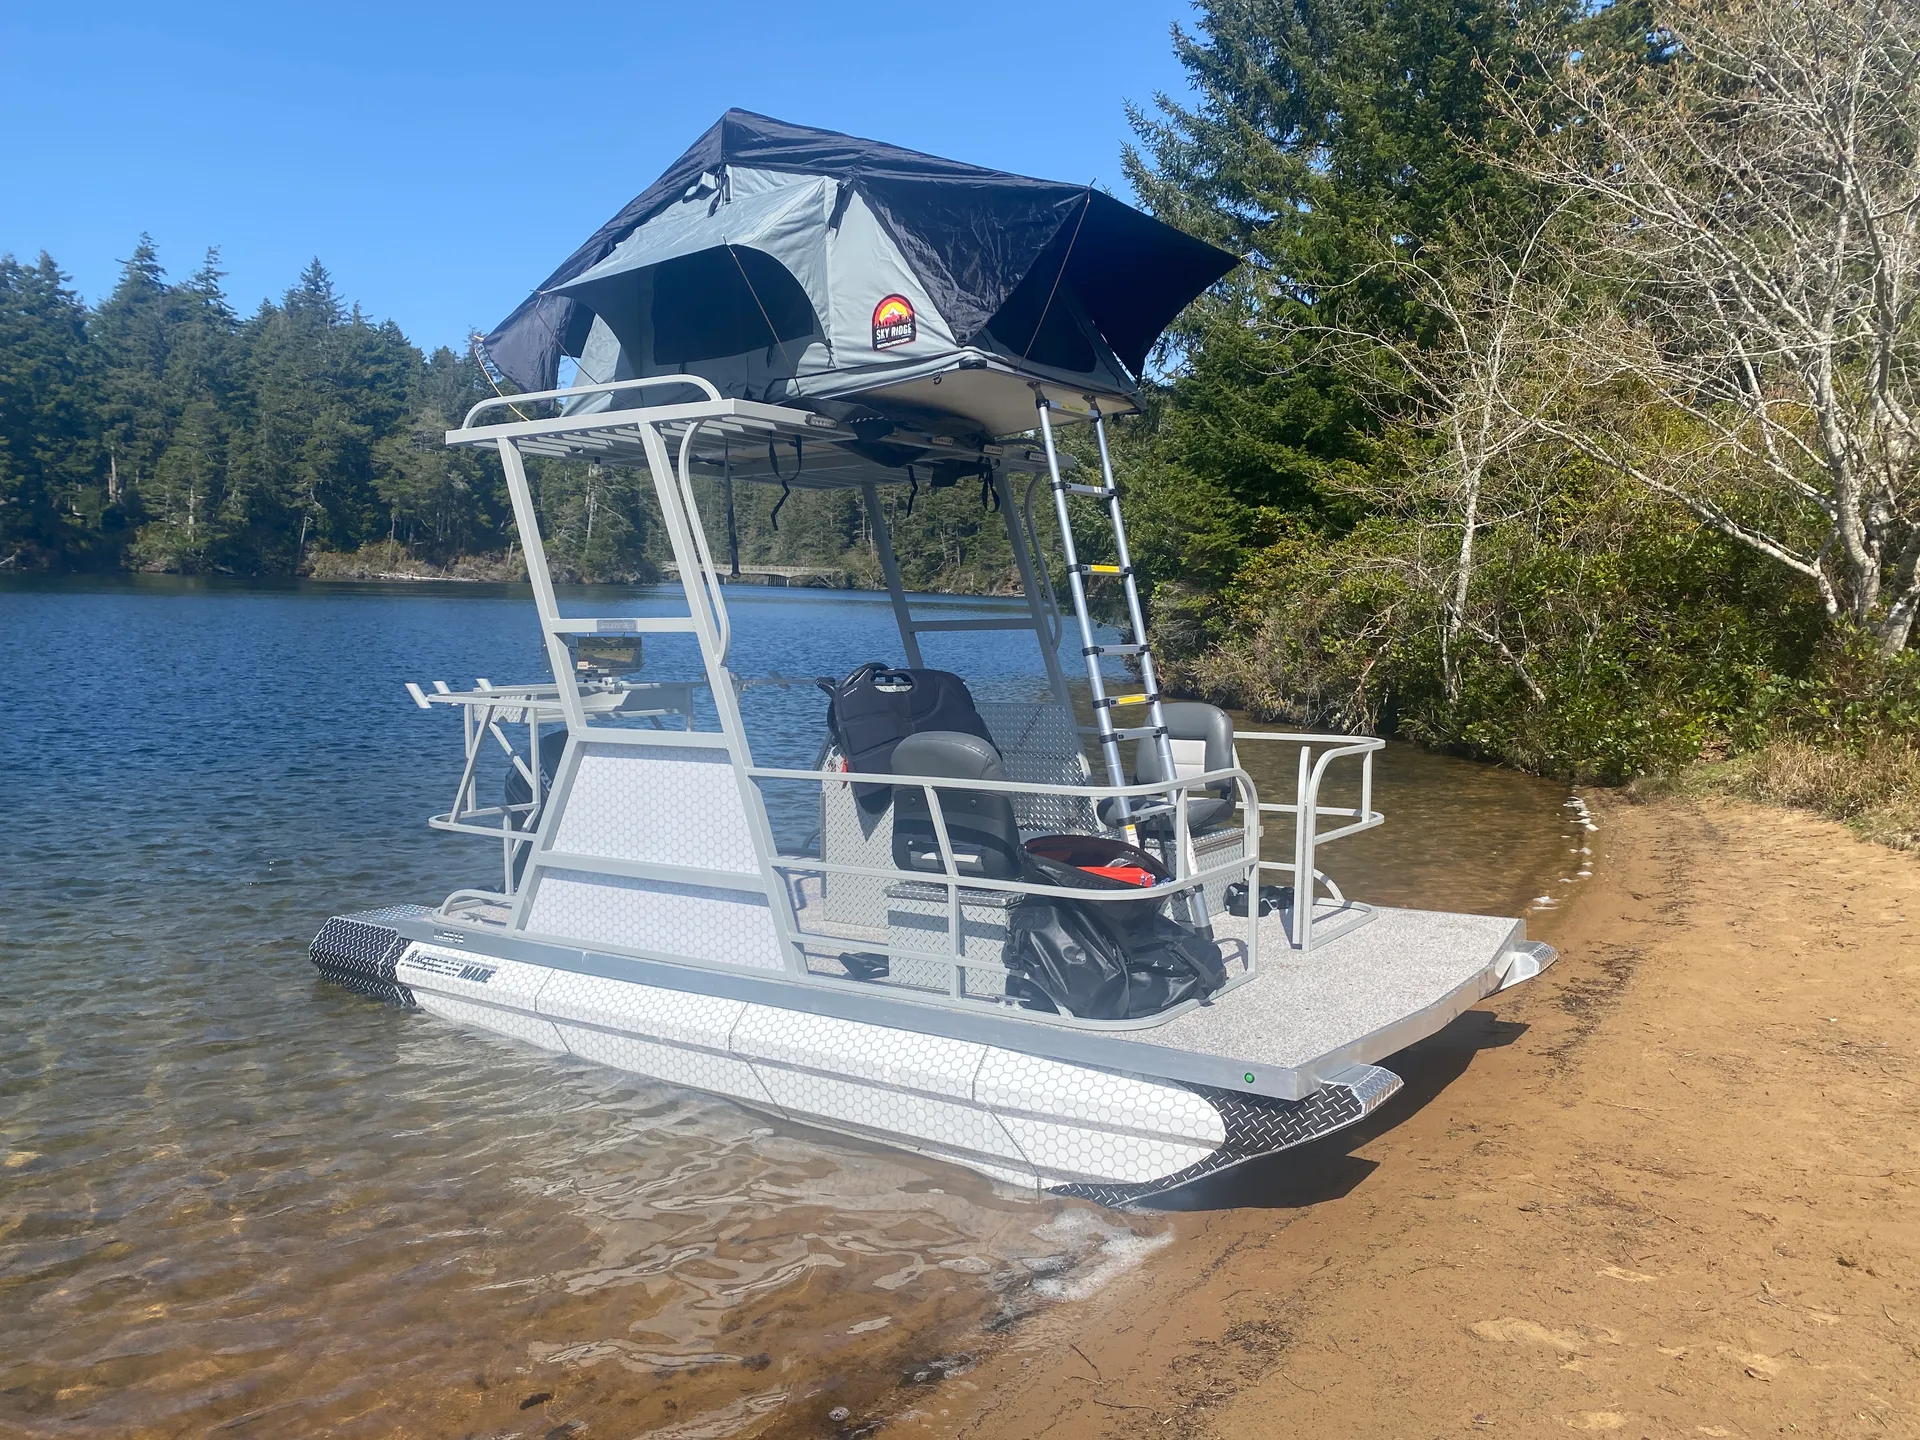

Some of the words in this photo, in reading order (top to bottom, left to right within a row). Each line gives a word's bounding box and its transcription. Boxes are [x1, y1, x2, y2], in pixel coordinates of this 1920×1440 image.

[876, 328, 890, 340] SKY
[891, 324, 912, 336] RIDGE
[456, 965, 497, 983] MADE
